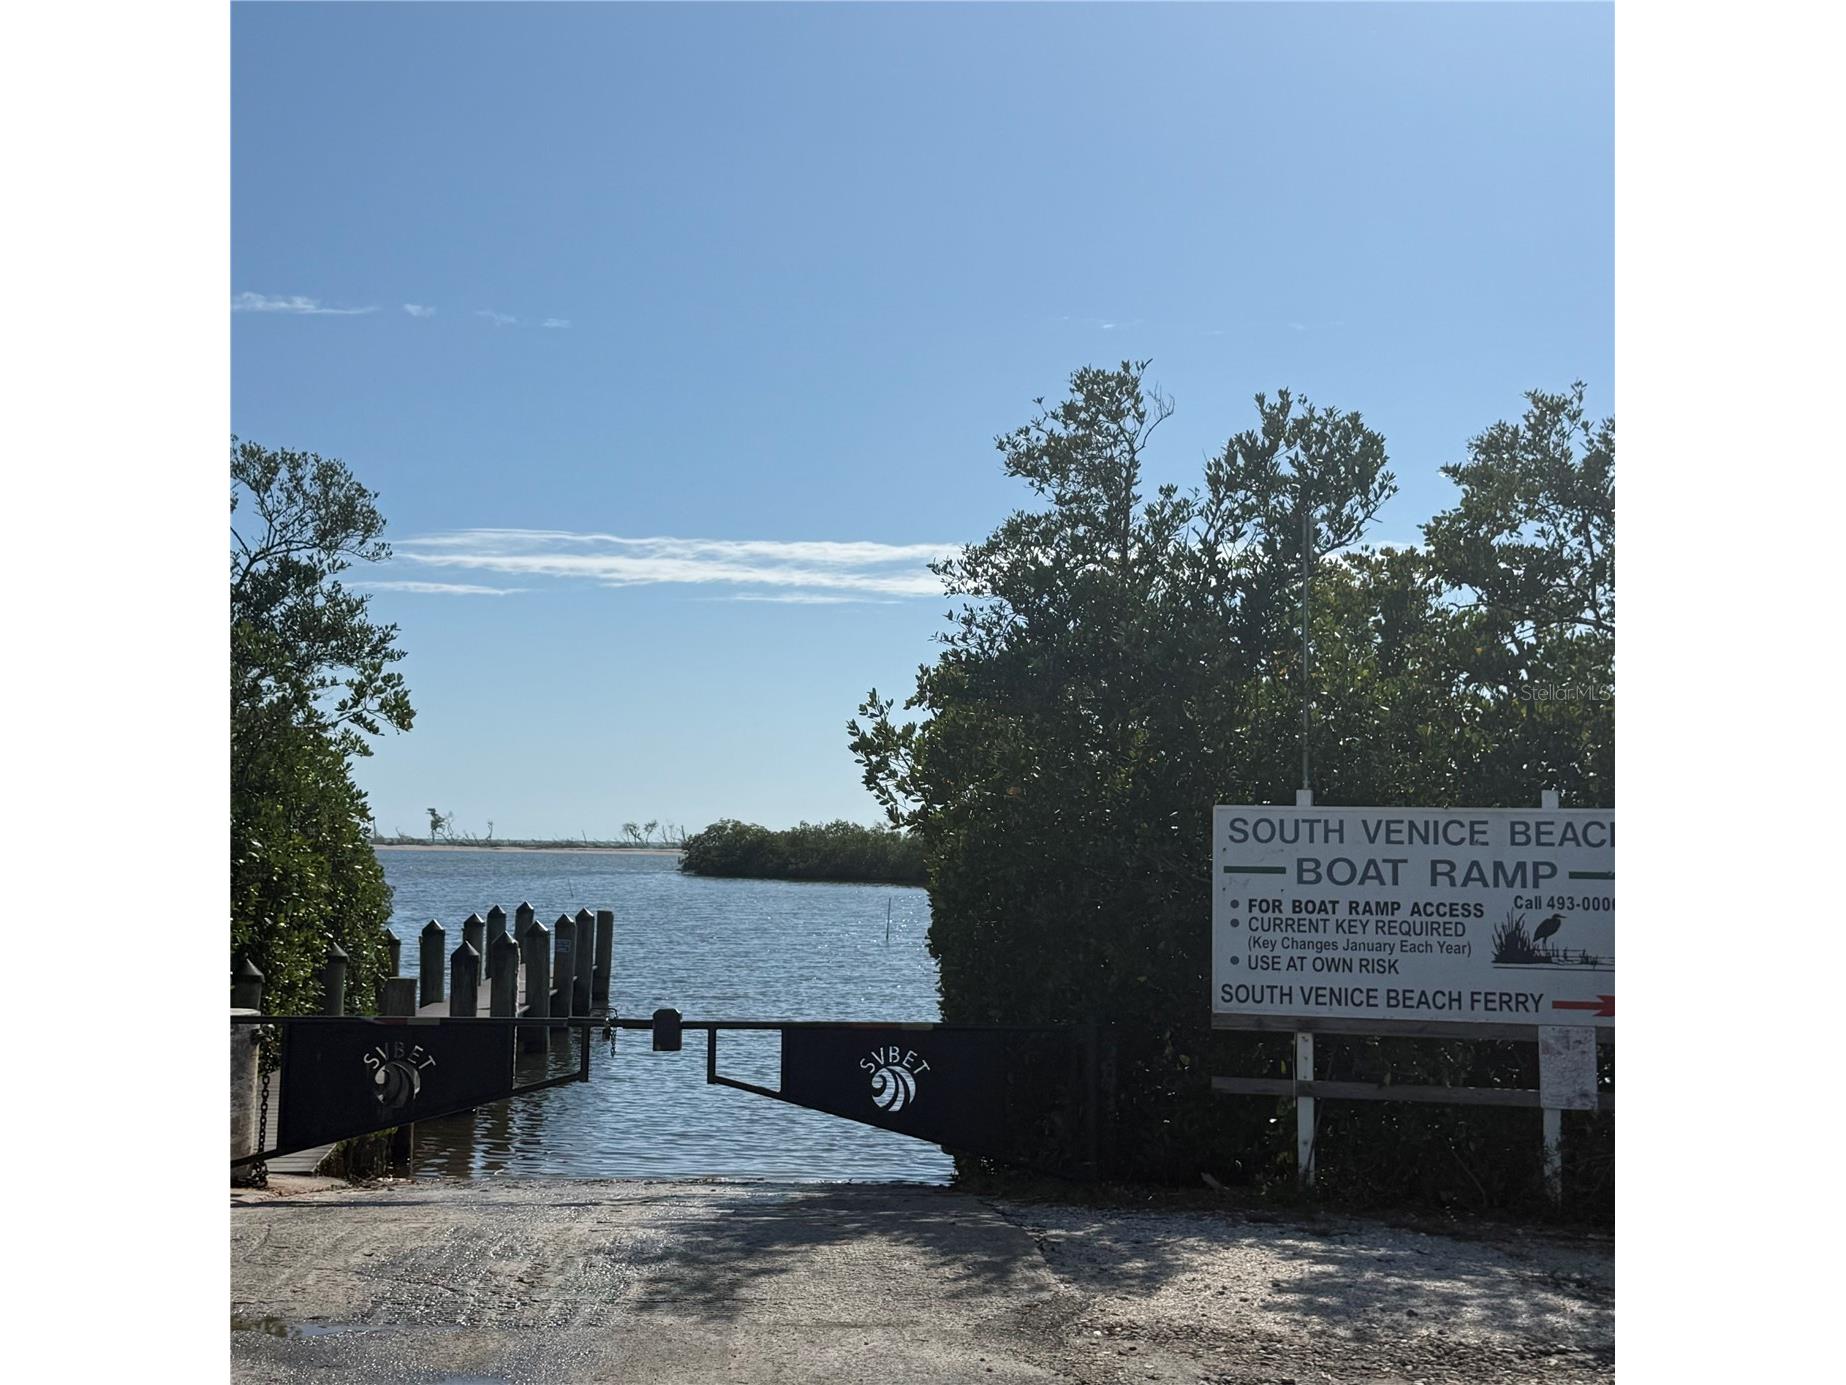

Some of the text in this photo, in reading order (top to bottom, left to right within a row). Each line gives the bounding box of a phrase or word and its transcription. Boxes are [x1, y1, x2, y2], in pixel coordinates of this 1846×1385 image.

[1228, 817, 1345, 844] SOUTH
[1361, 819, 1489, 846] VENICE
[1296, 857, 1558, 889] BOAT RAMP
[1248, 898, 1485, 918] FOR BOAT RAMP ACCESS
[1513, 895, 1542, 910] Call
[1248, 917, 1466, 937] CURRENT KEY REQUIRED
[1248, 936, 1472, 958] (Key Changes January Each Year)
[1247, 955, 1400, 974] USE AT OWN RISK
[1220, 983, 1544, 1013] SOUTH VENICE BEACH FERRY
[860, 1046, 930, 1073] SVBET
